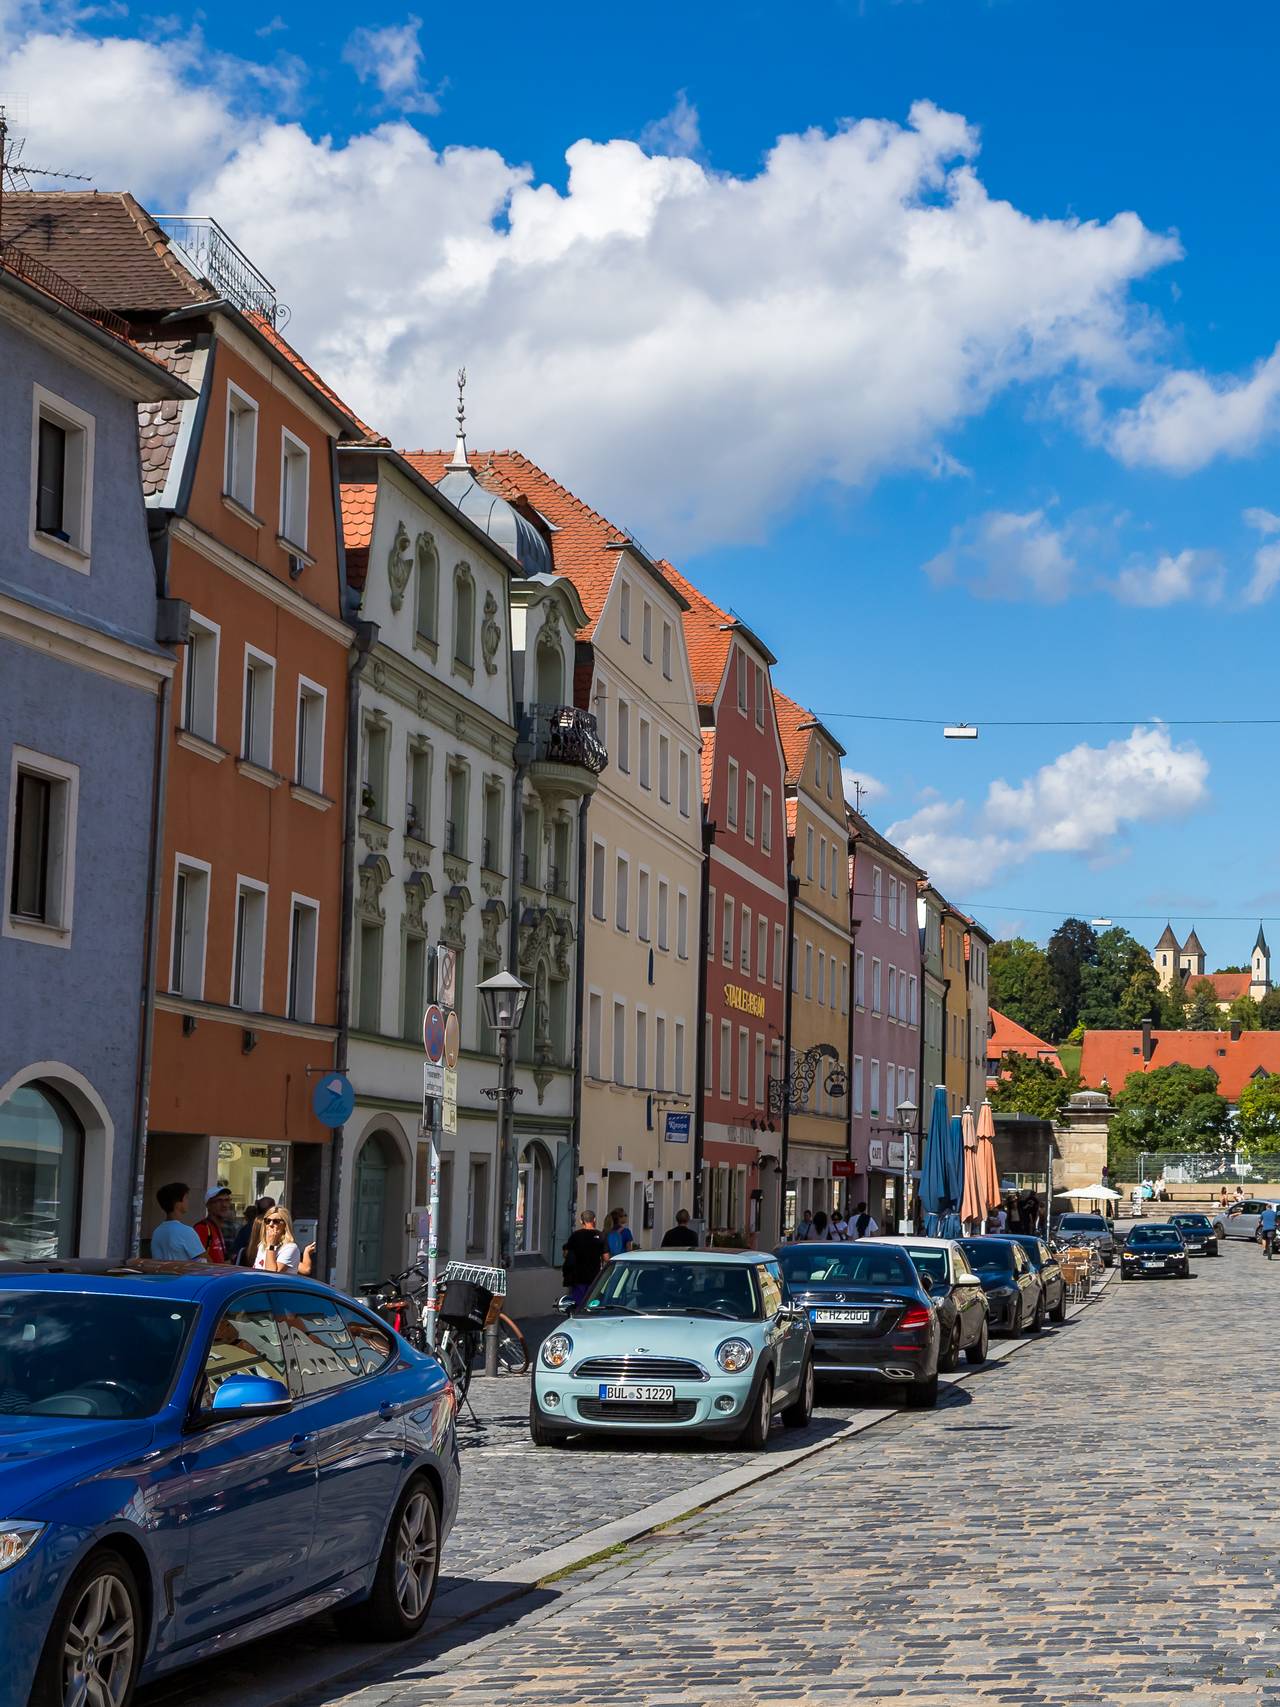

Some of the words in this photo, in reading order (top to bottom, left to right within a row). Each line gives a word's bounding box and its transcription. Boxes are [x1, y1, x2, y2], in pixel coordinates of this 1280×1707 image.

[816, 1310, 823, 1320] R
[829, 1310, 841, 1320] HZ
[607, 1387, 627, 1399] BUL
[636, 1388, 643, 1400] S
[645, 1388, 672, 1400] 1229
